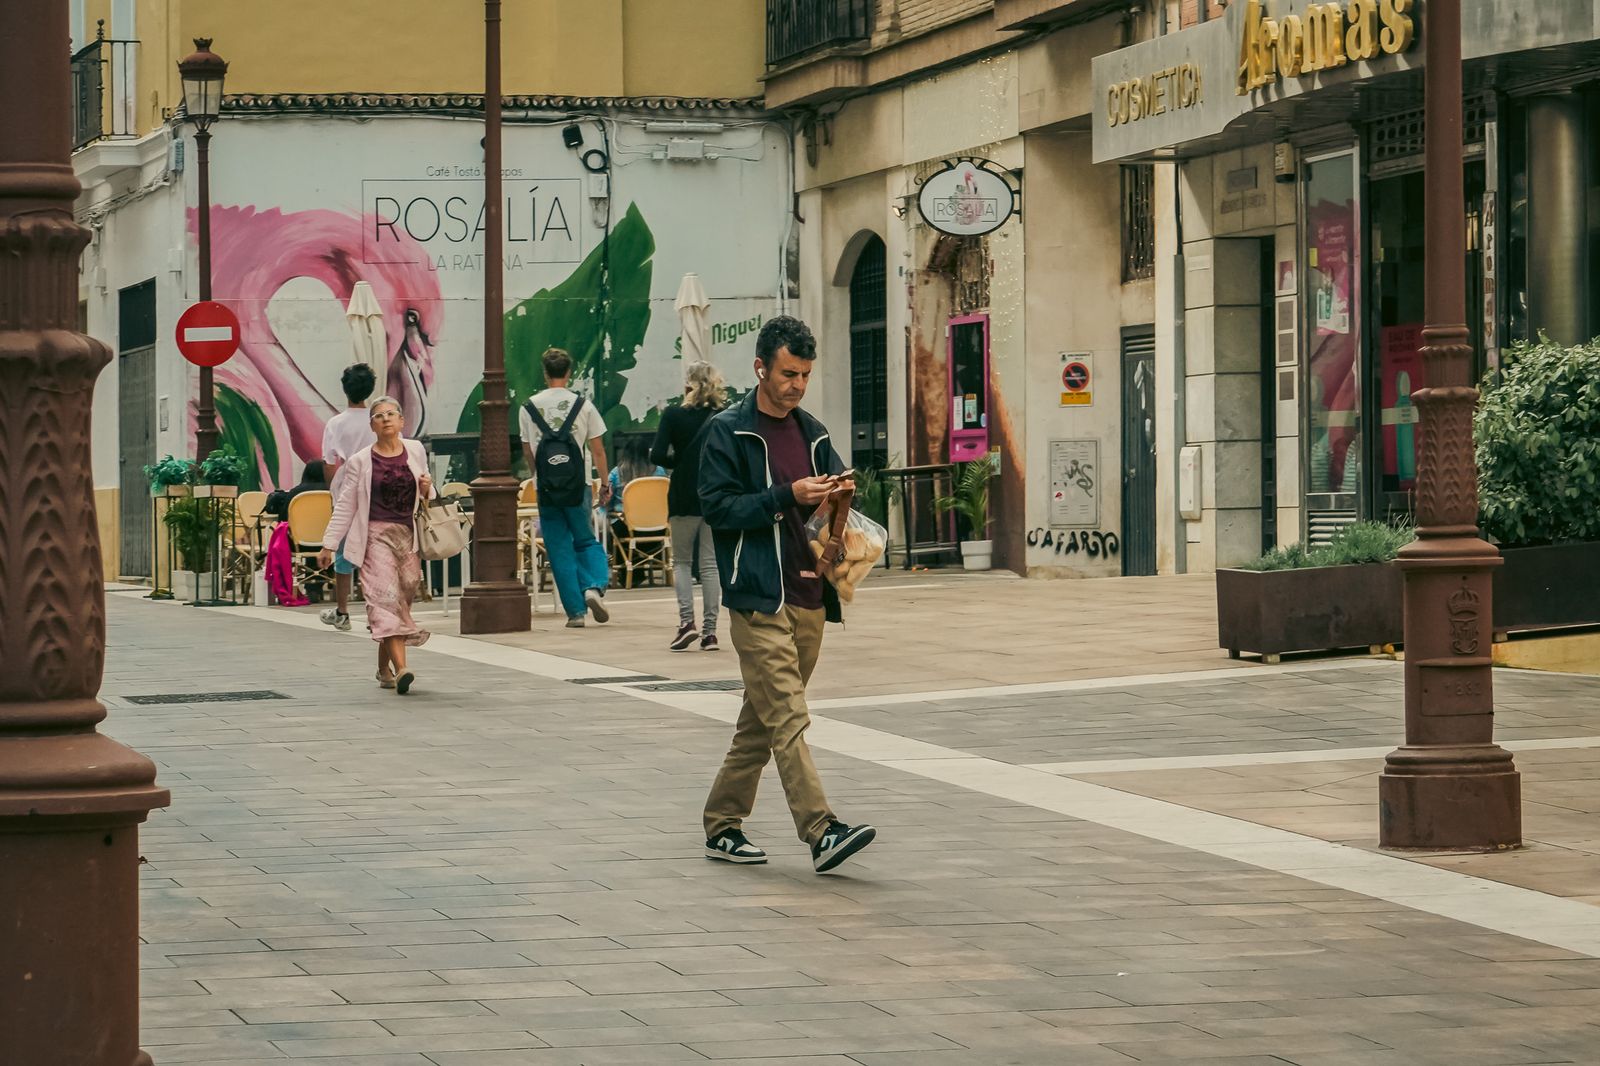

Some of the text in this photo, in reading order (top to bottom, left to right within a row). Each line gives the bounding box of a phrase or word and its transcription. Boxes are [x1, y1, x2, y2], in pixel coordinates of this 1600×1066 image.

[1235, 0, 1414, 96] Aromas
[1108, 62, 1204, 127] COSMETICA
[426, 166, 450, 177] Café
[427, 254, 524, 271] LA RATNA
